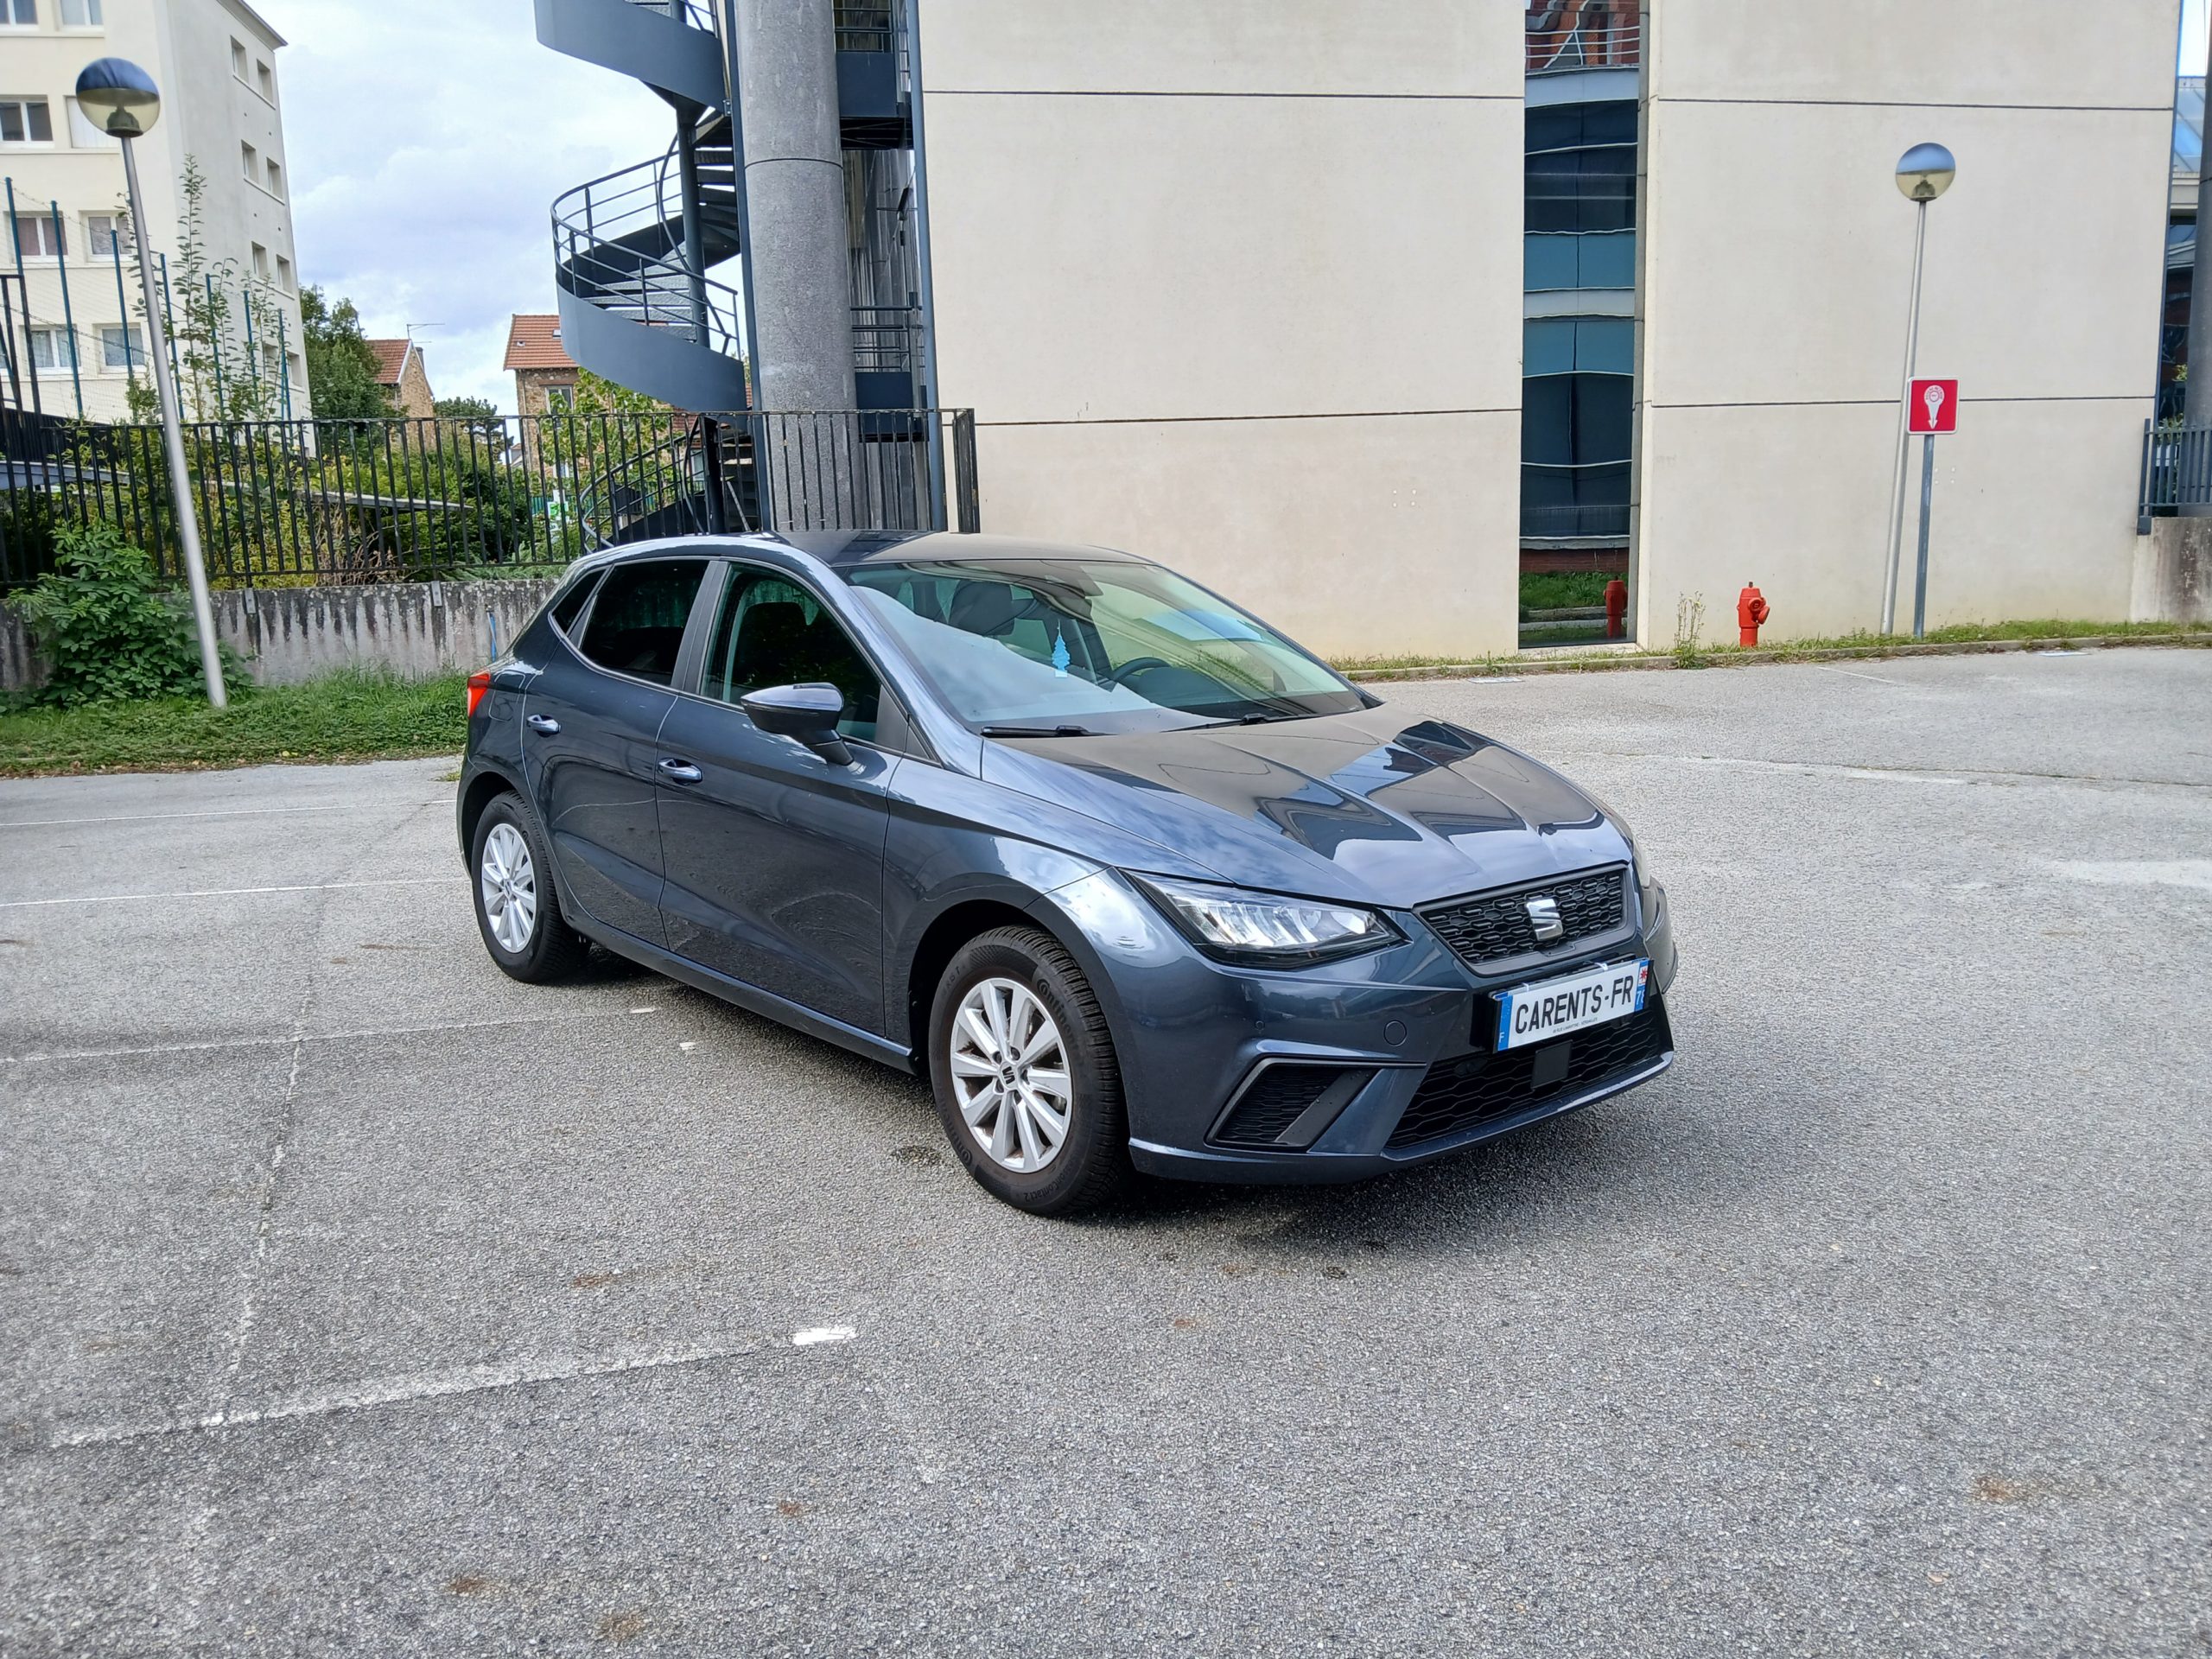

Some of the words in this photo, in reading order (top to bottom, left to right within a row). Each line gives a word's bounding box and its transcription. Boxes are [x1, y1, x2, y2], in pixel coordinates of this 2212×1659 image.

[1037, 978, 1084, 1067] Continent
[1516, 976, 1633, 1033] CARENTS-FR
[1498, 1032, 1505, 1043] F
